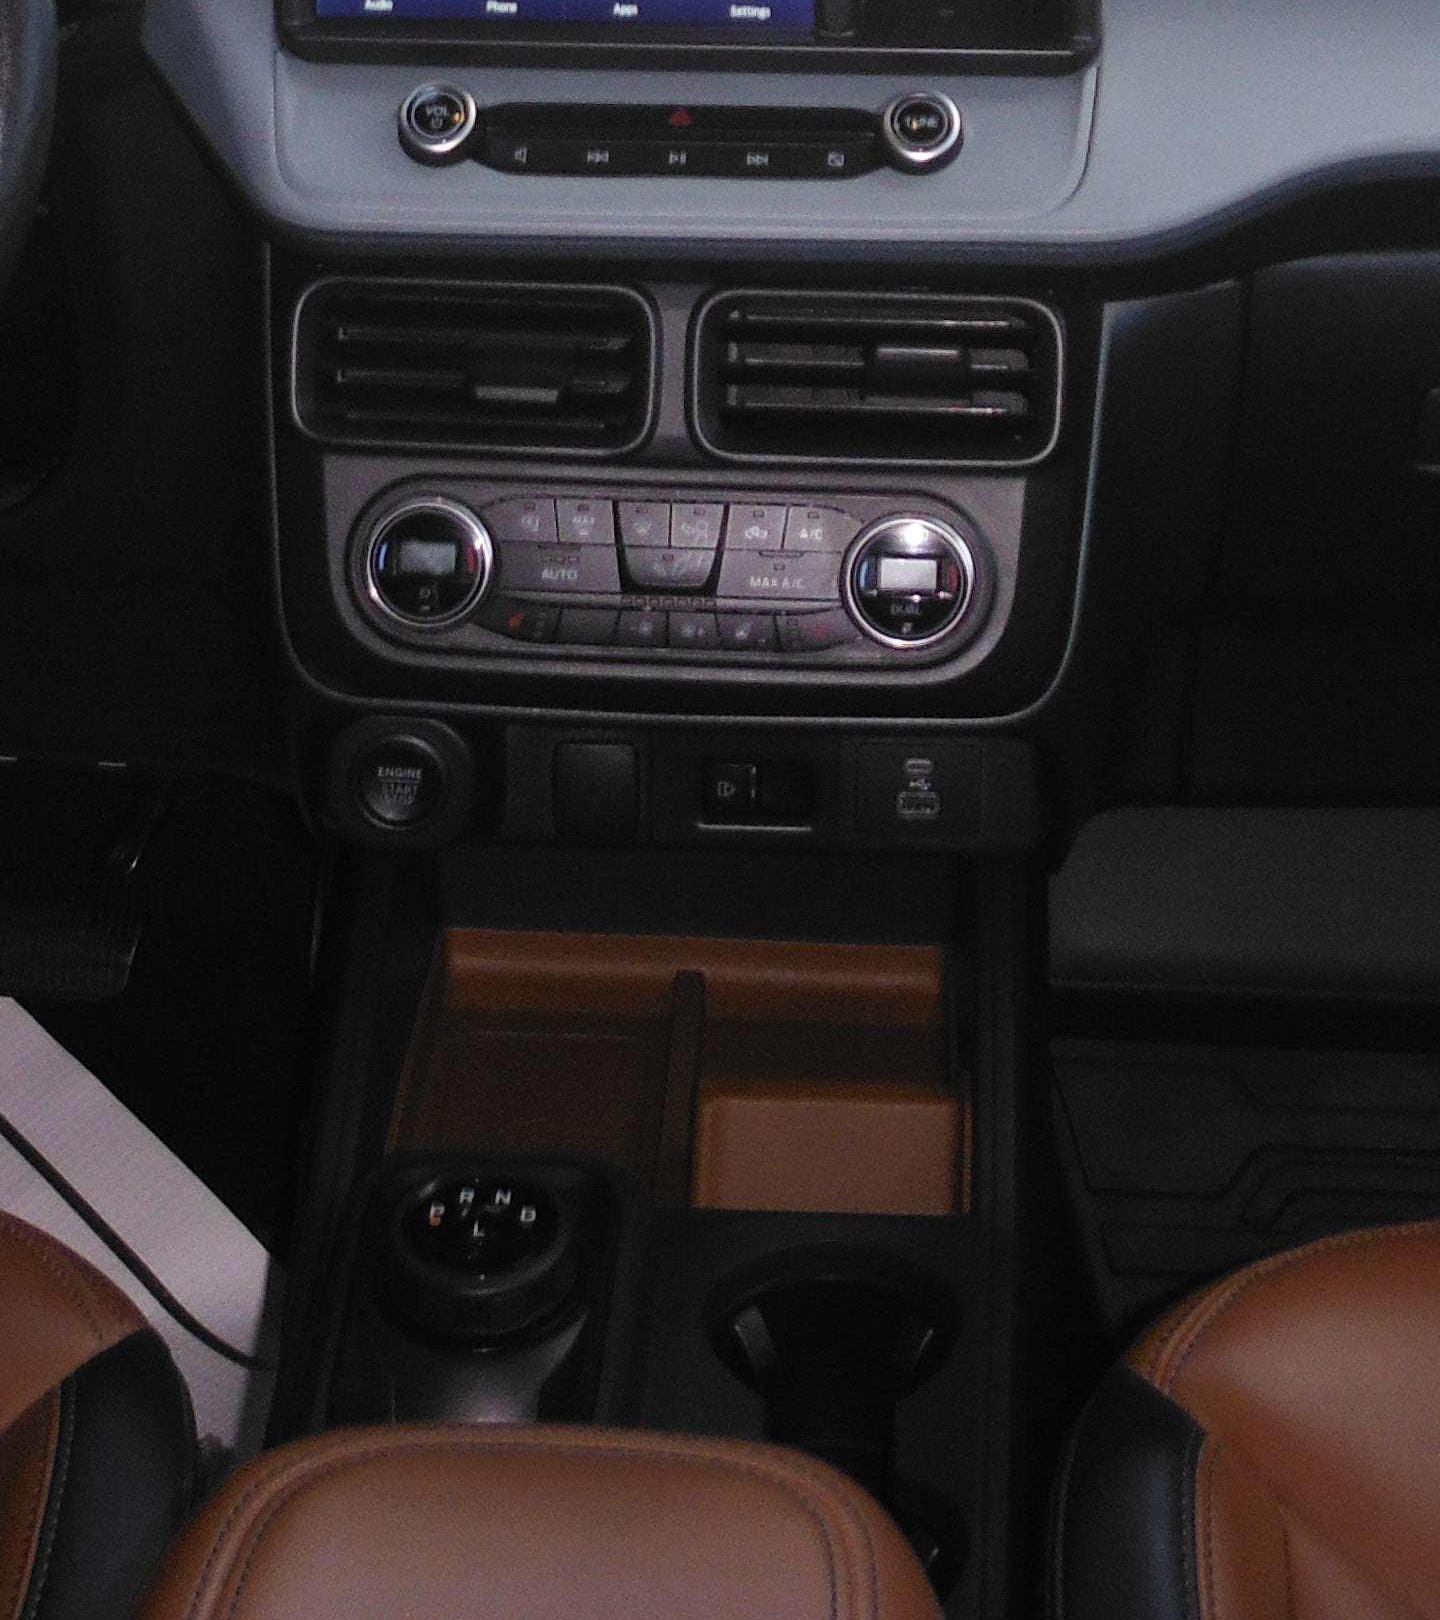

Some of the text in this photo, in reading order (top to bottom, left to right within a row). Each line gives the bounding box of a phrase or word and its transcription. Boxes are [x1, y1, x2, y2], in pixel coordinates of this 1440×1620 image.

[729, 3, 772, 21] Settings
[799, 528, 824, 540] A/C
[541, 567, 579, 580] AUTO
[750, 576, 805, 589] MAX A/C
[377, 766, 422, 780] ENGINE
[459, 1186, 475, 1205] R
[494, 1187, 512, 1205] N
[520, 1205, 537, 1223] D
